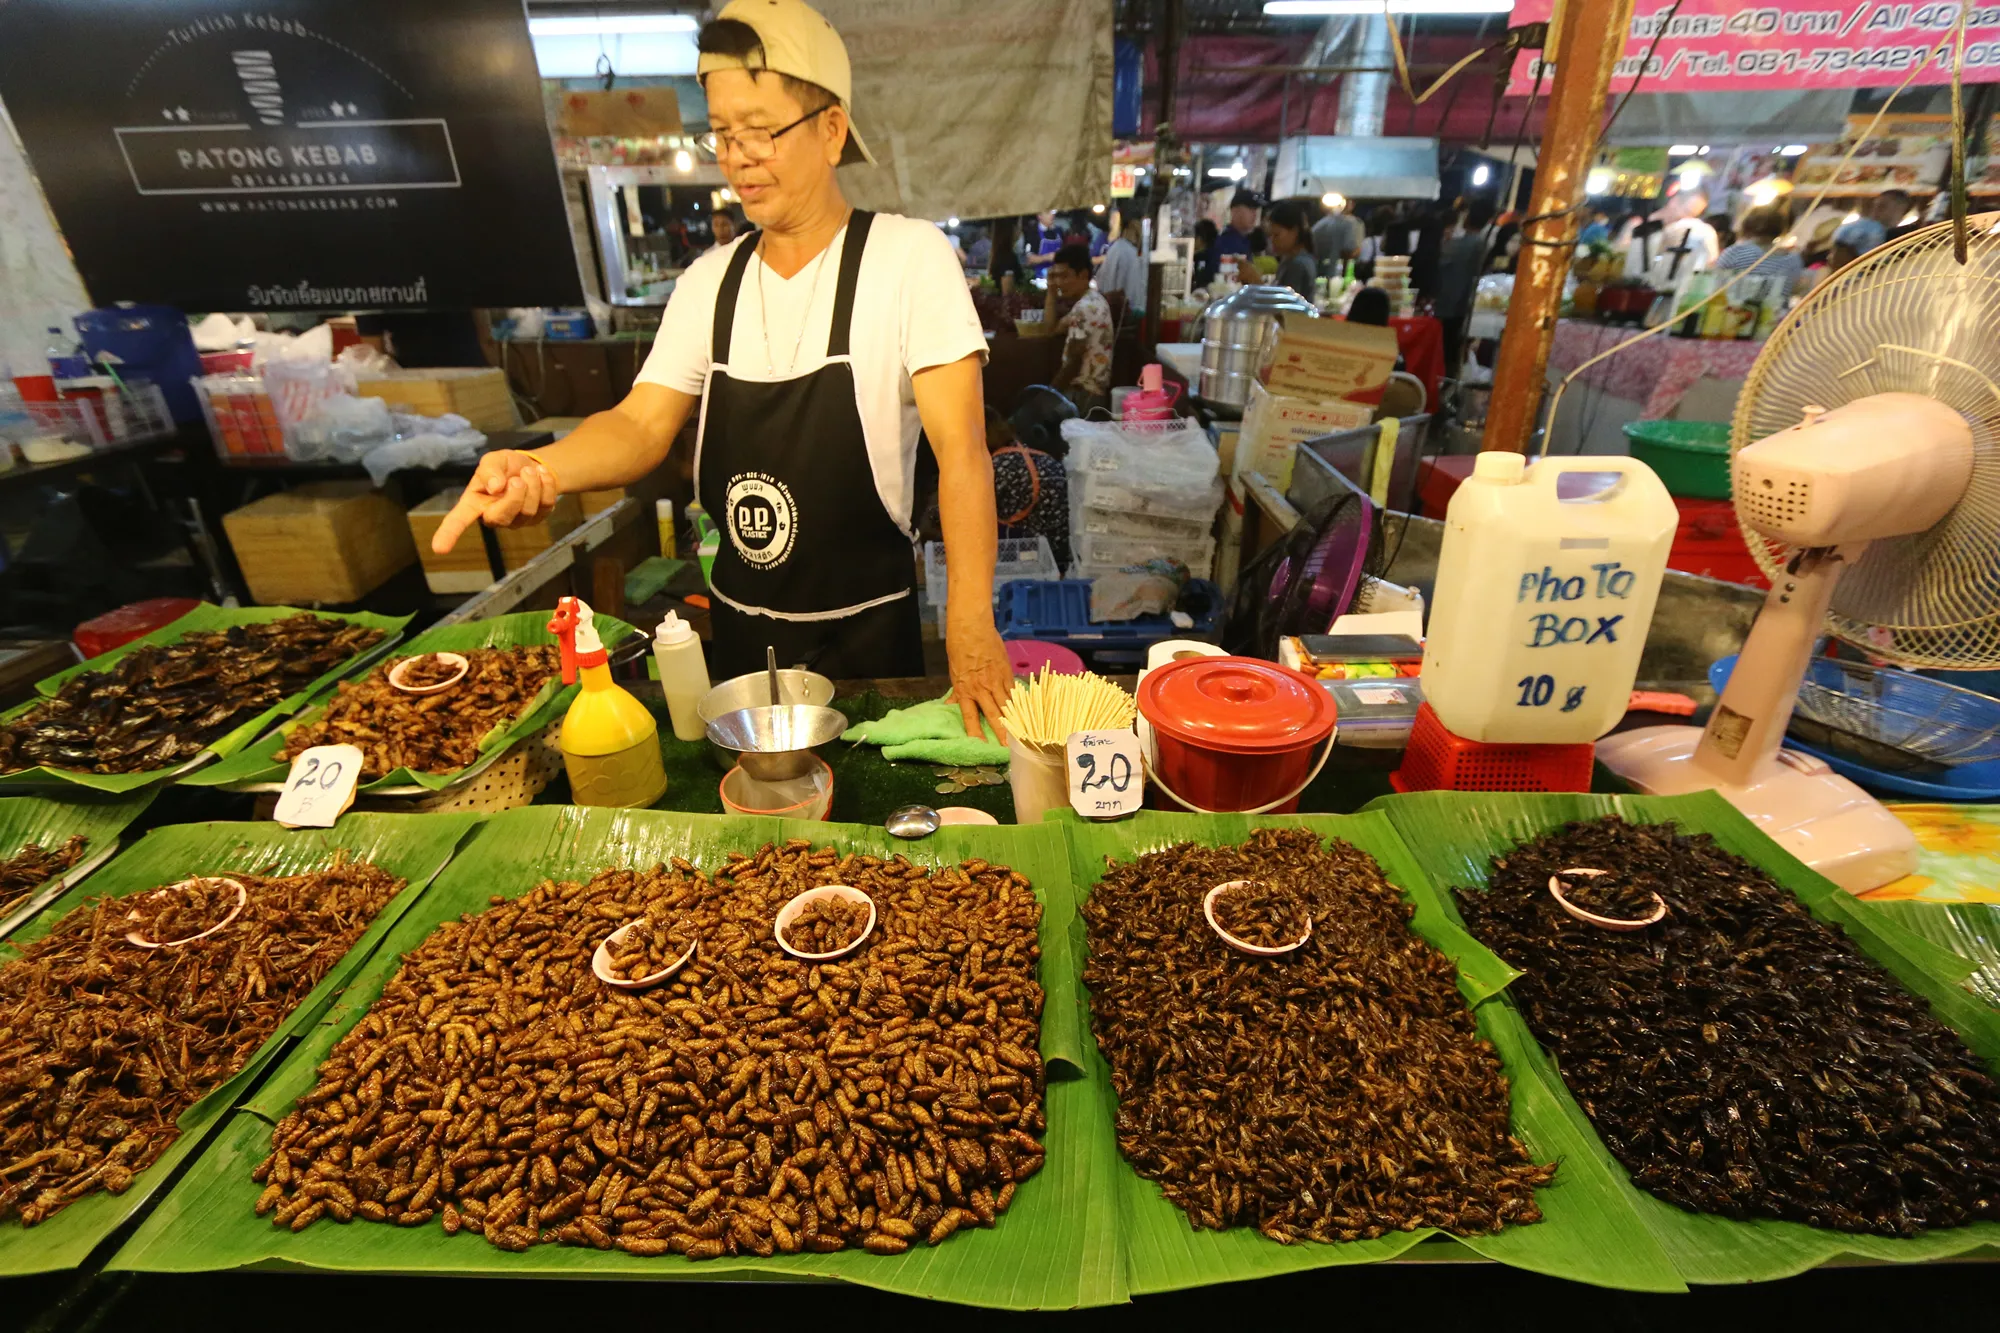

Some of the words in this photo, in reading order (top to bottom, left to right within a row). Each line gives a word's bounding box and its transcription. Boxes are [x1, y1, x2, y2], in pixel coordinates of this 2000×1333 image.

[168, 13, 236, 46] Turkish
[244, 12, 307, 37] Kebab
[1727, 8, 1780, 35] 40
[1862, 4, 1912, 31] All
[1911, 2, 1961, 29] 40
[177, 146, 284, 170] PATONG
[289, 144, 378, 167] KEBAB
[1516, 674, 1554, 707] 10
[292, 758, 342, 792] 20
[1076, 753, 1131, 793] 20
